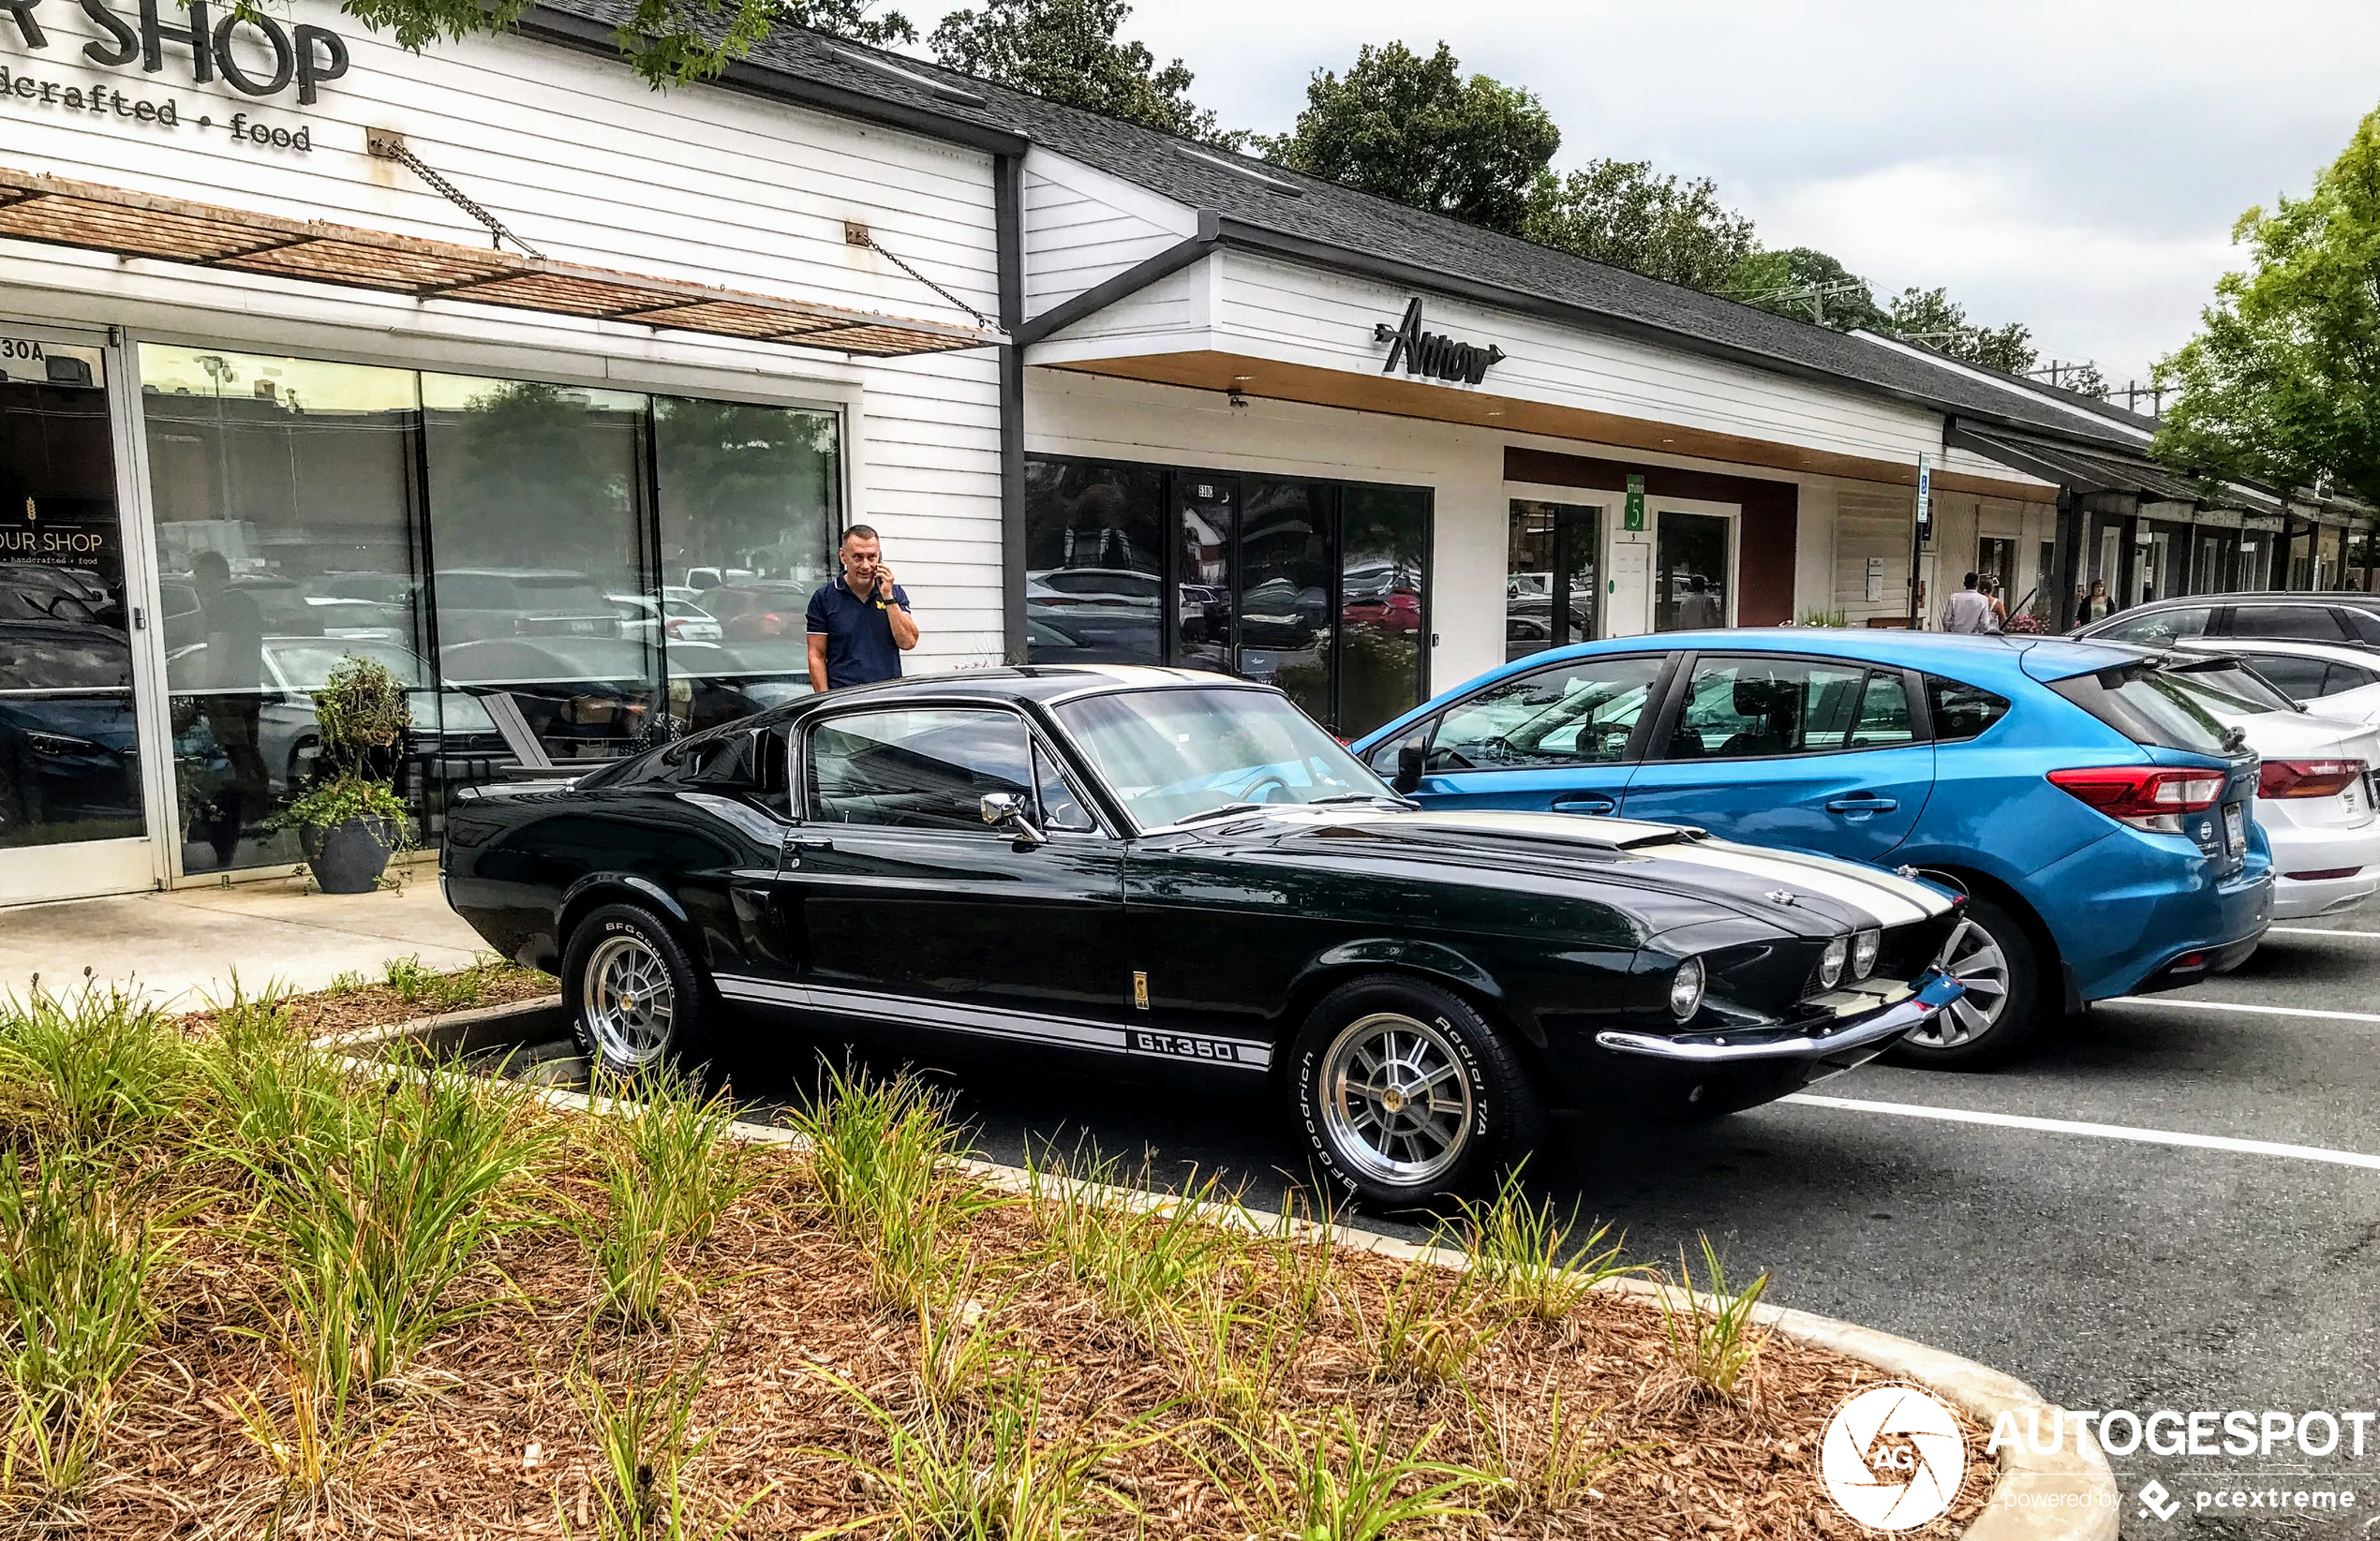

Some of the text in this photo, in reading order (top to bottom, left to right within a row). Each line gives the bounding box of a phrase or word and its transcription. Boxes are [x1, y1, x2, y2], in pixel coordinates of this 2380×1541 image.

[81, 0, 350, 105] SHOP
[231, 112, 312, 152] food
[2, 339, 45, 362] 30A
[1382, 297, 1488, 384] Arrow
[1631, 498, 1640, 527] 5
[10, 556, 98, 566] handcrafted food
[43, 532, 103, 553] SHOP
[1435, 1015, 1489, 1136] Radial T/A
[1298, 1050, 1359, 1191] BFGoodrich
